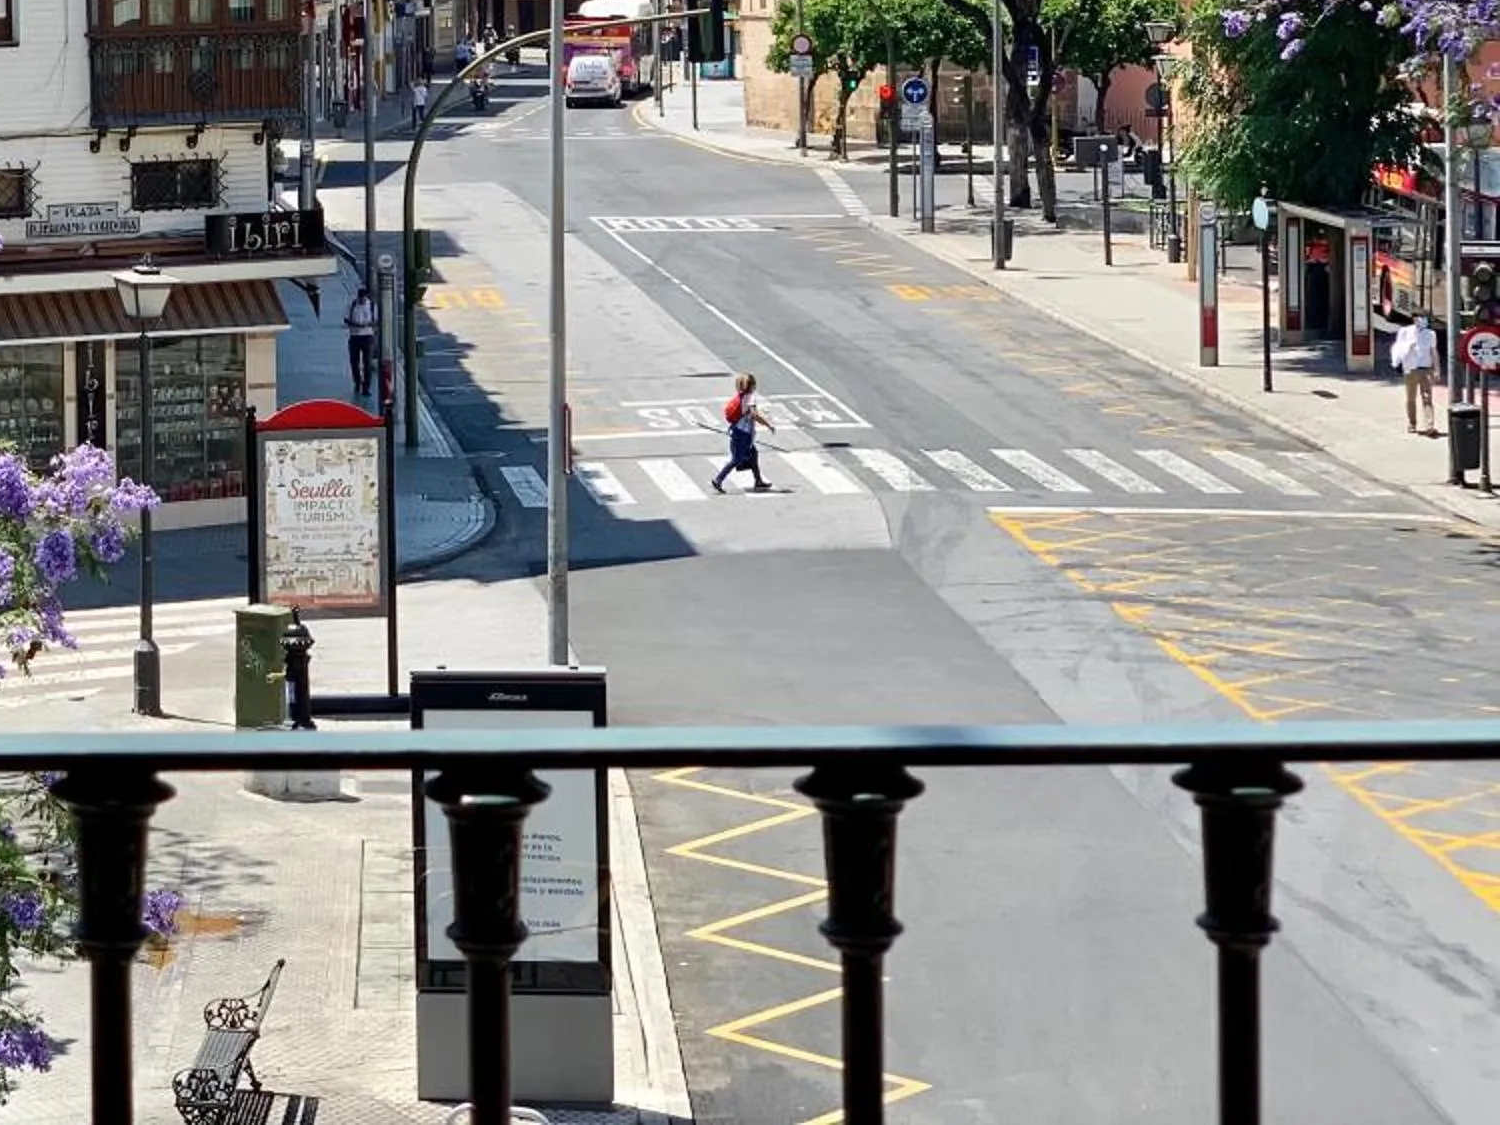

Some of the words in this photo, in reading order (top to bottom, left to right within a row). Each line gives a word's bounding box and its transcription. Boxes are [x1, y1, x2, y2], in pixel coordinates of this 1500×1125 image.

[85, 340, 99, 441] ibir
[287, 478, 353, 500] Sevilla
[293, 499, 355, 512] IMPACTO
[295, 511, 355, 524] TURISMO
